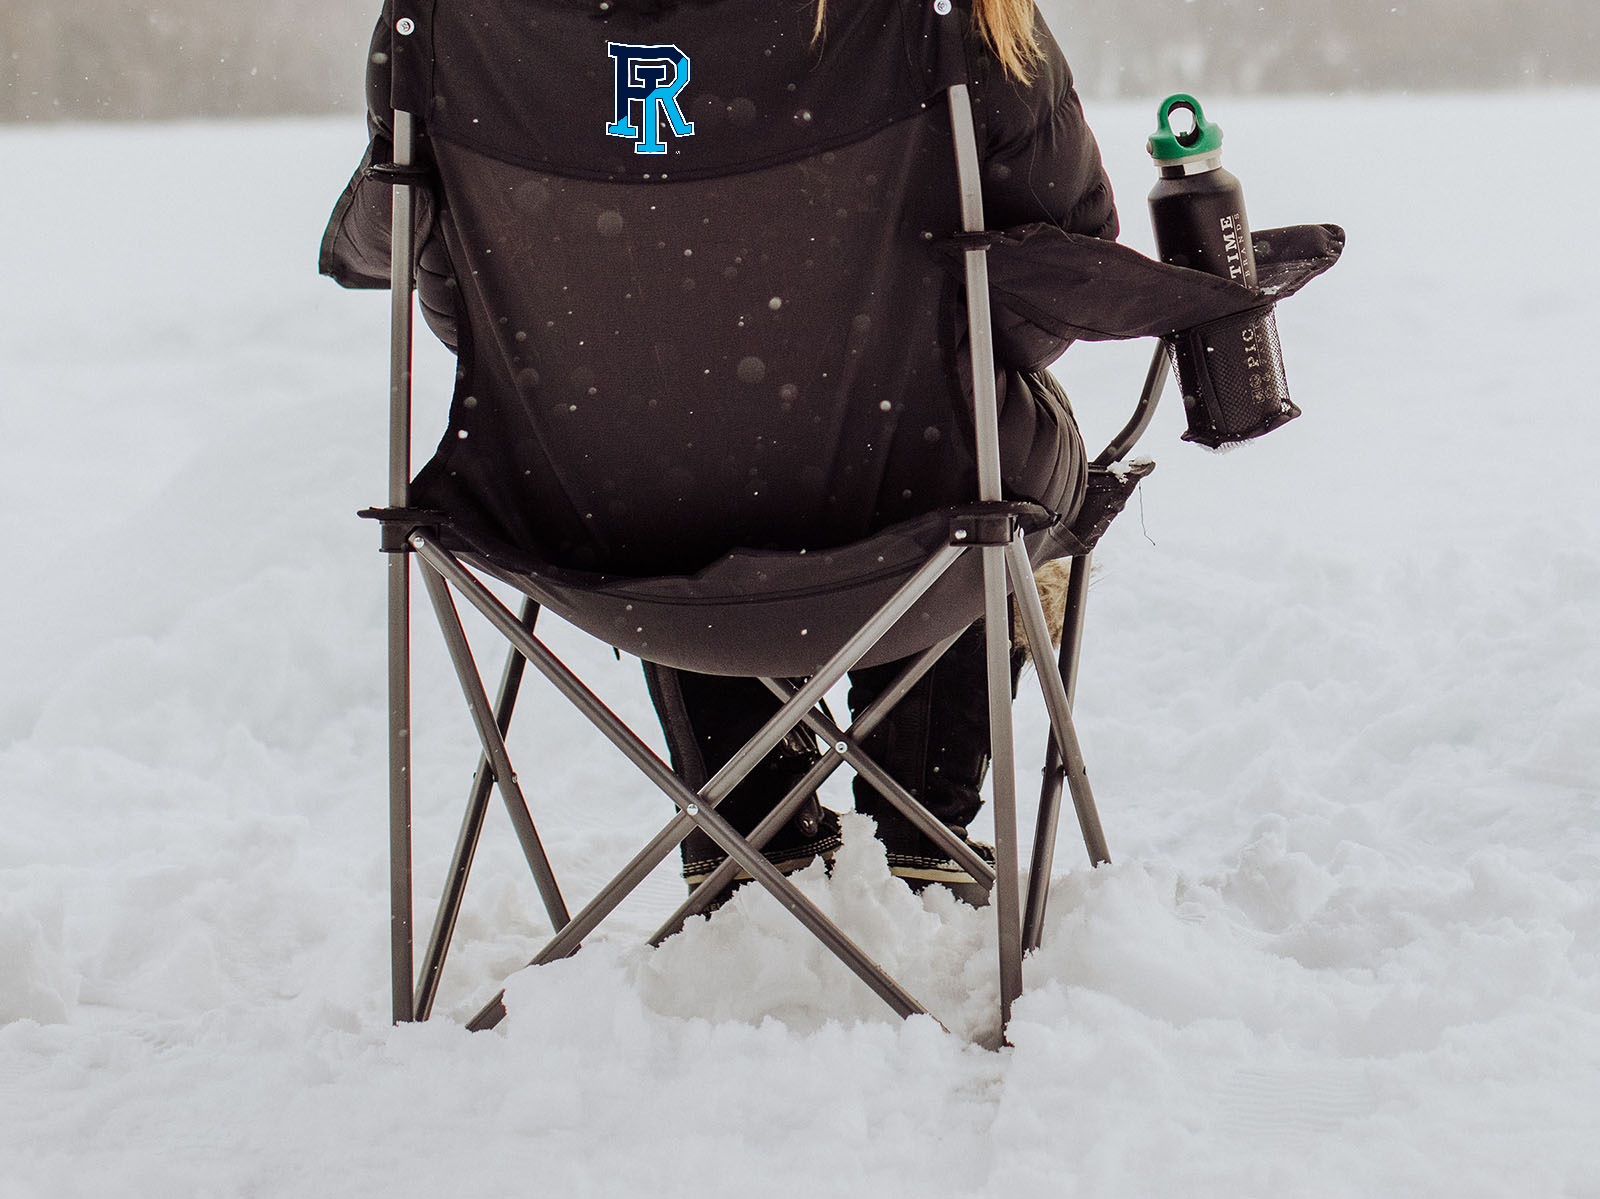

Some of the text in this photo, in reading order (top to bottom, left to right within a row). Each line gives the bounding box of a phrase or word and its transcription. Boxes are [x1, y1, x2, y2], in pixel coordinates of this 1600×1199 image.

[1220, 216, 1260, 369] PIC TIME
[1234, 213, 1251, 277] BRANDS
